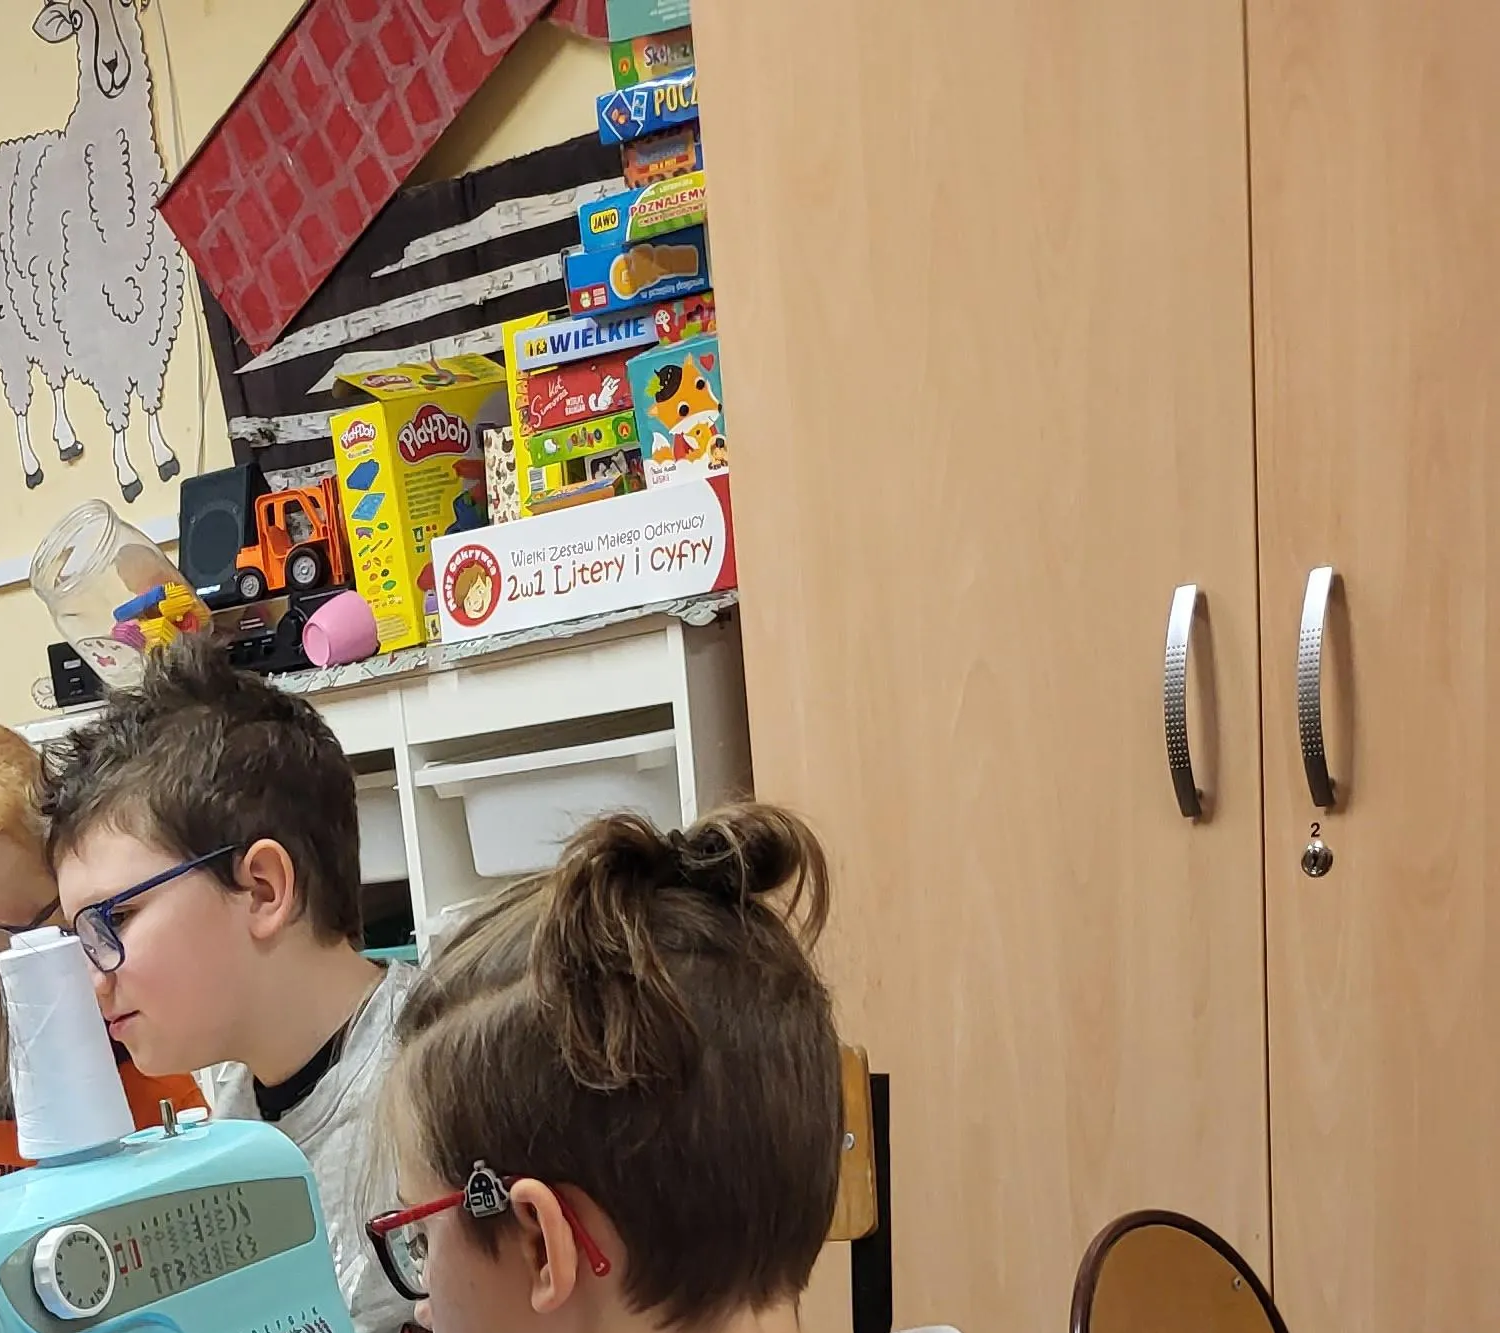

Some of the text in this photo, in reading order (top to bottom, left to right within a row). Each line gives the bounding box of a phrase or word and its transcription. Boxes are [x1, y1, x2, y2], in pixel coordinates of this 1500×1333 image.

[630, 187, 706, 217] POZNAJEMY
[593, 211, 617, 230] JAWO
[549, 316, 646, 354] WIELKIE
[510, 550, 546, 568] Wielki
[549, 540, 594, 562] Zestaw
[644, 513, 706, 541] Odkrywcy
[507, 569, 546, 602] 2w1
[553, 553, 626, 595] Litery
[635, 546, 640, 576] i
[1310, 822, 1321, 838] 2
